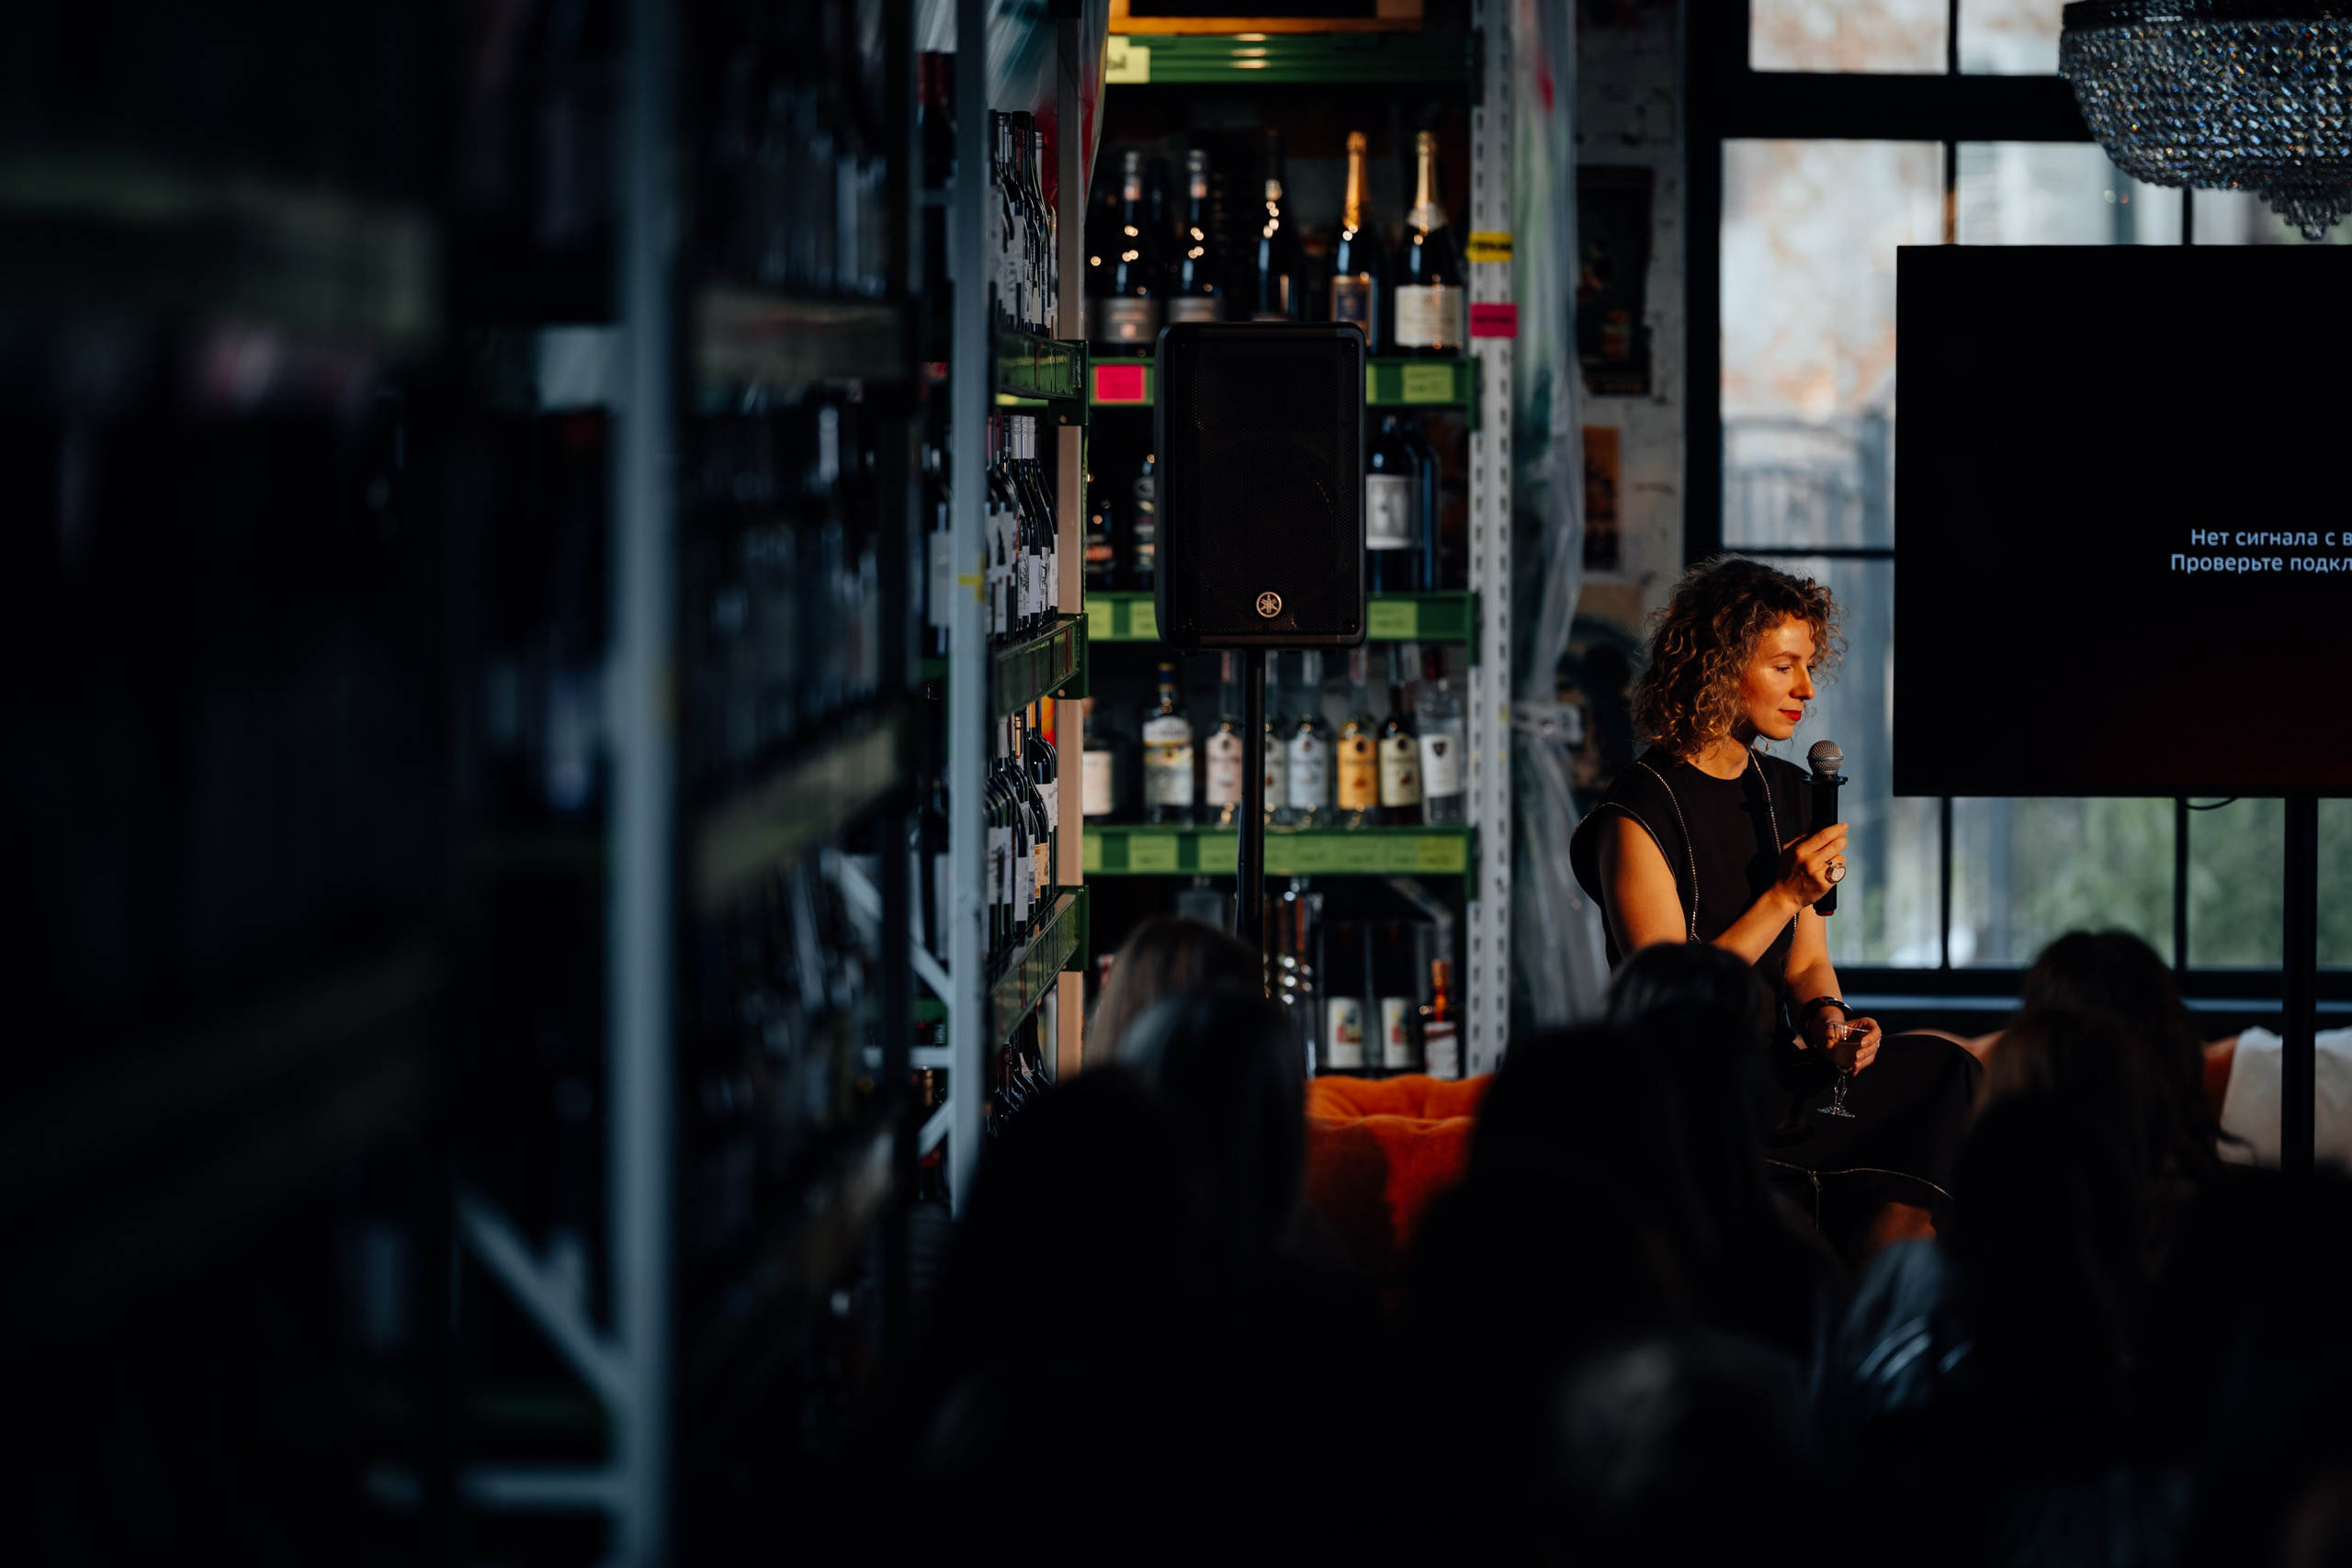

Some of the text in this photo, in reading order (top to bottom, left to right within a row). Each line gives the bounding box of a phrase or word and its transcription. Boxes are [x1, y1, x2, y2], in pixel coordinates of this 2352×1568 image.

[2191, 528, 2230, 547] Нет
[2235, 531, 2318, 547] сигнала
[2324, 531, 2335, 547] с
[2171, 553, 2283, 574] Проверьте
